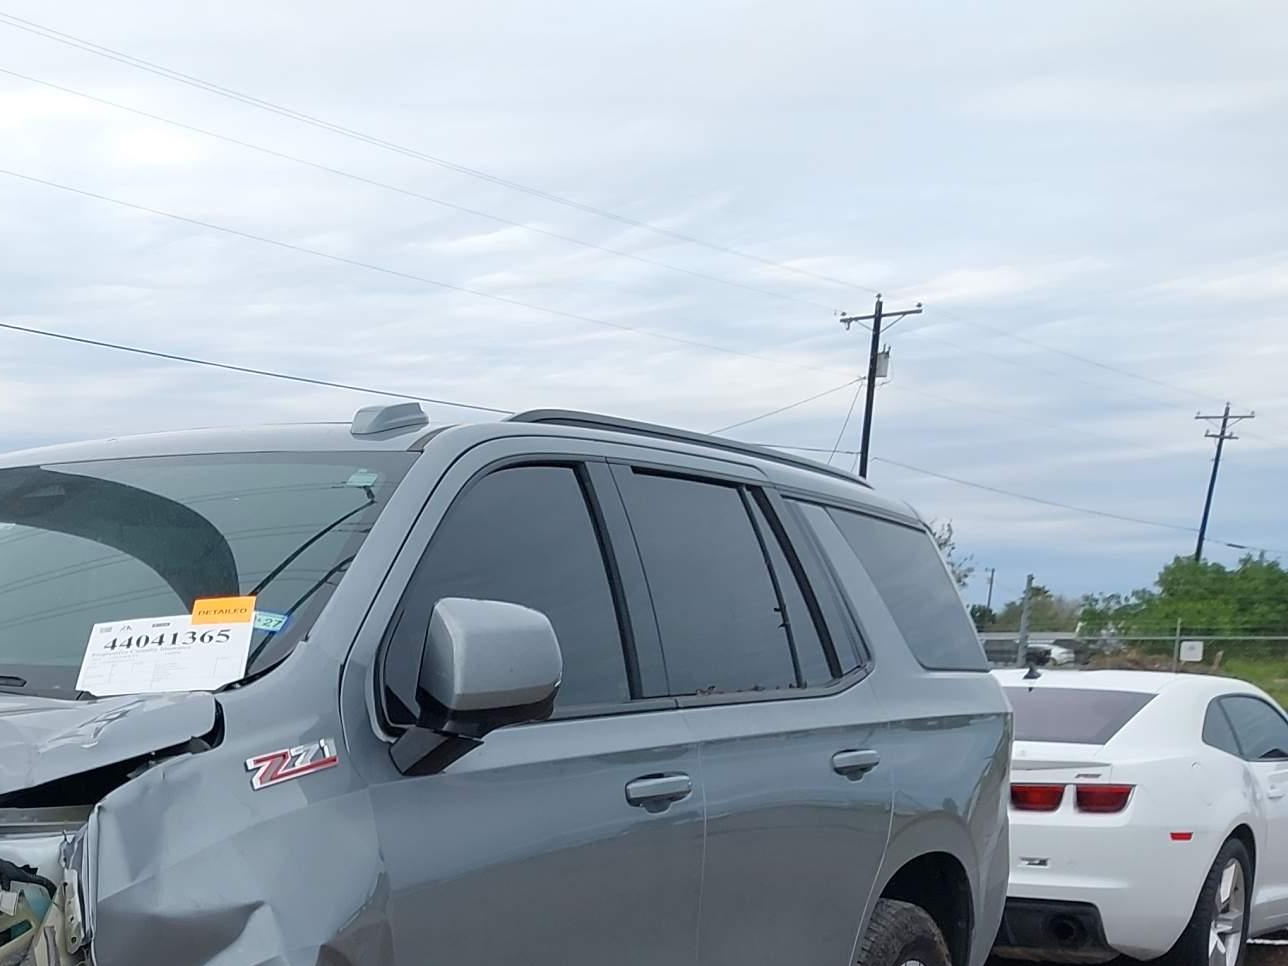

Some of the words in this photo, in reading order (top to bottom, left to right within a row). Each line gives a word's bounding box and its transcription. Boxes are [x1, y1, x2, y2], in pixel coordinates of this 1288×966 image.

[198, 607, 248, 616] DETAILED
[263, 617, 283, 629] 27
[104, 628, 231, 650] 44041365
[245, 739, 338, 791] Z71
